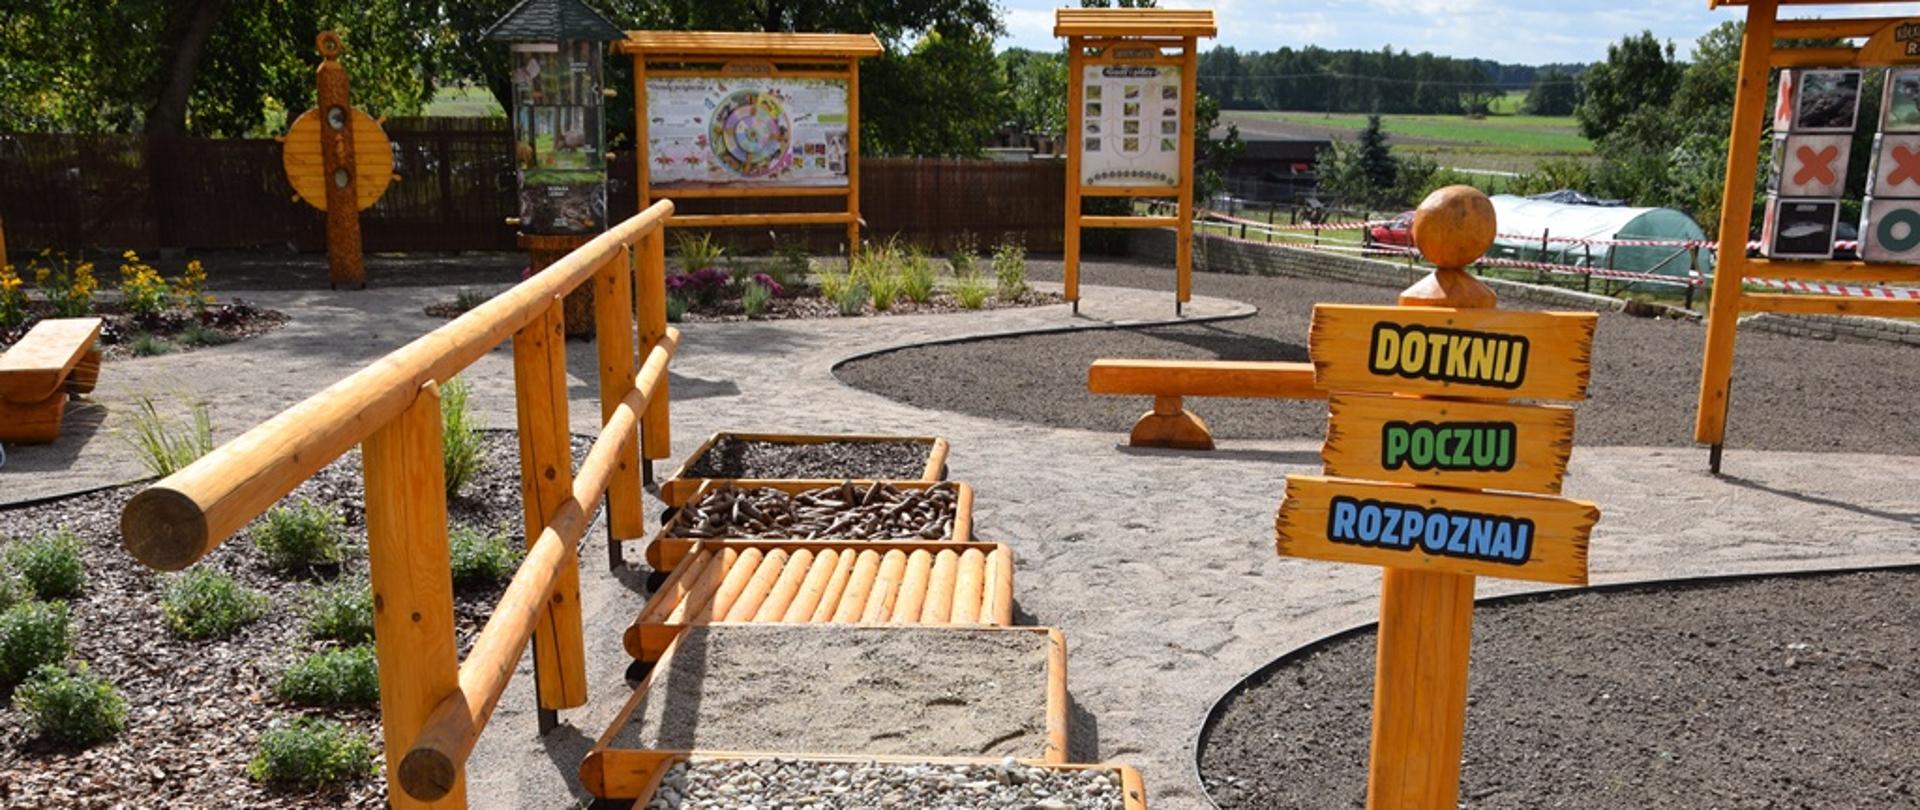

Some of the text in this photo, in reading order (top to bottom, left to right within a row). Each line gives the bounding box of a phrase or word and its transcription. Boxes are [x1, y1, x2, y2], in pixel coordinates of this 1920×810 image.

[1374, 328, 1524, 383] DOTKNIJ
[1386, 427, 1511, 467] POCZUJ
[1331, 501, 1529, 560] ROZPOZNAJ
